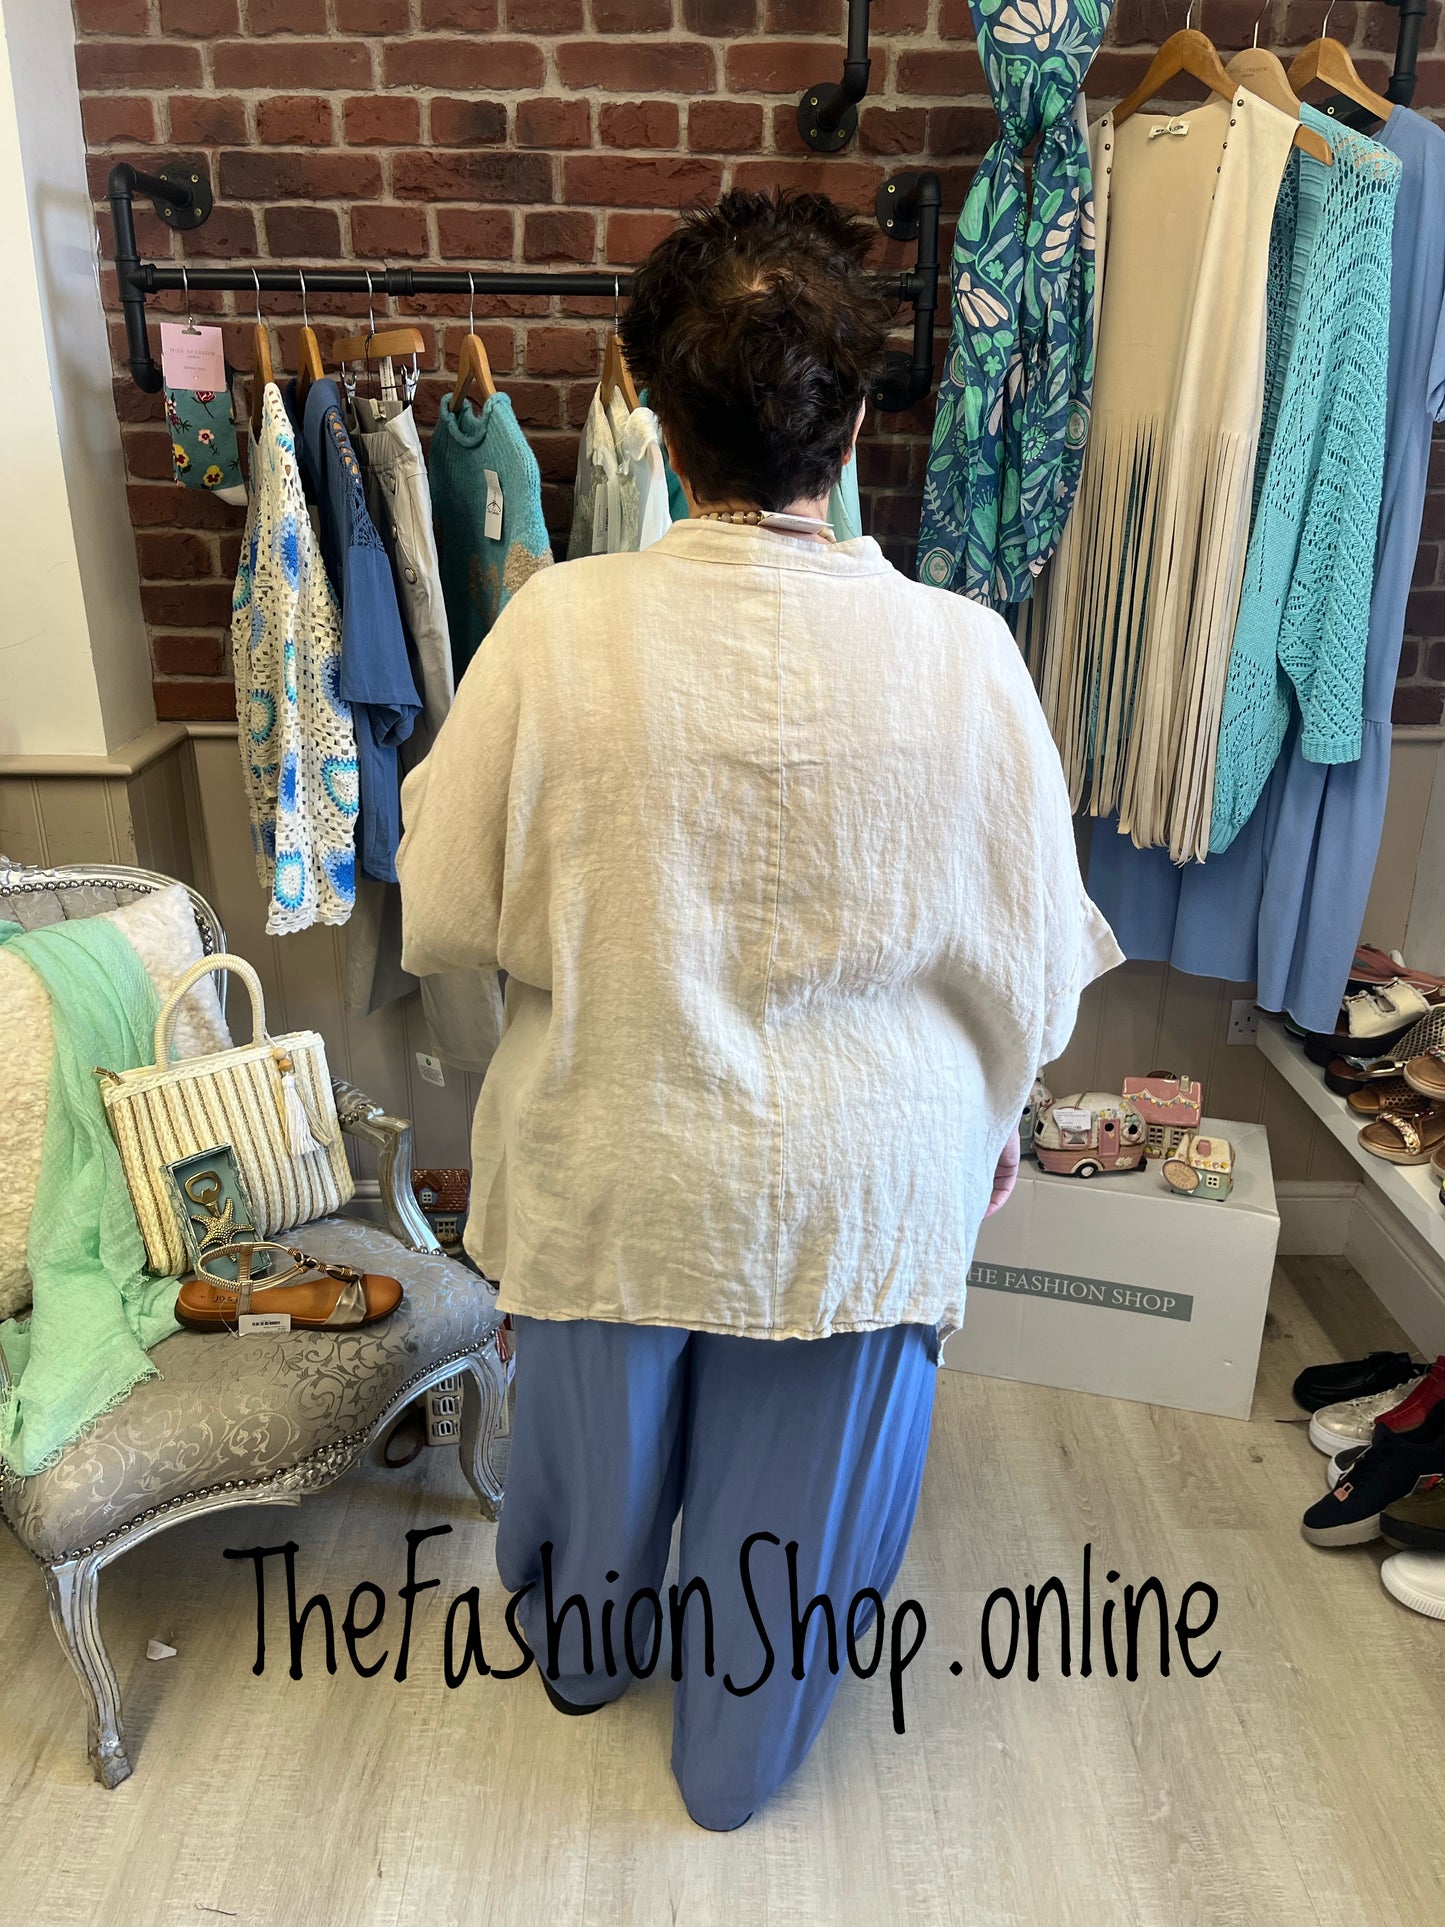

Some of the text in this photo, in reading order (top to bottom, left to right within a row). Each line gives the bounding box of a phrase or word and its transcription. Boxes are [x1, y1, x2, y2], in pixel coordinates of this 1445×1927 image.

[966, 1267, 1176, 1313] HE FASHION SHOP
